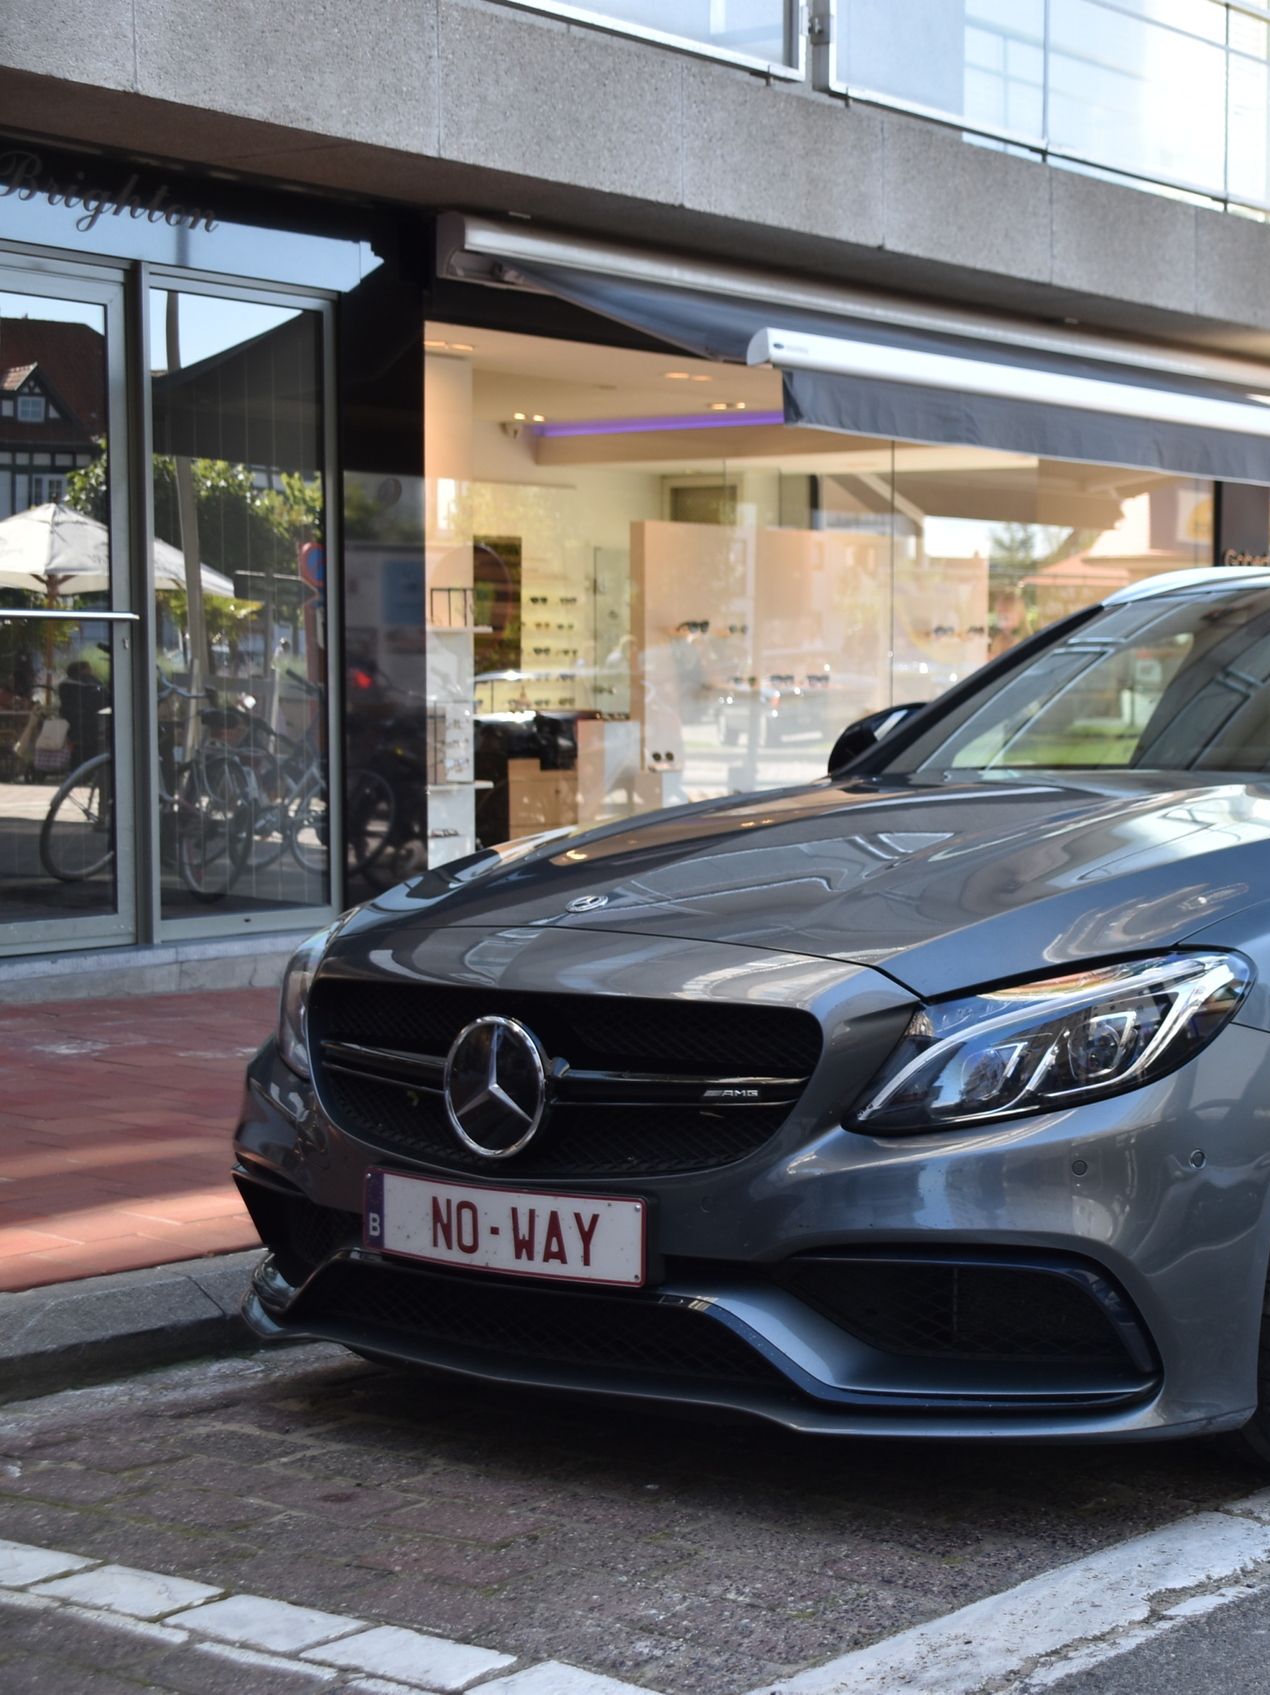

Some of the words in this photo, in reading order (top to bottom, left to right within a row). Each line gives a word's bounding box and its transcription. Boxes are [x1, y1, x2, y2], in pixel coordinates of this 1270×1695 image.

[0, 151, 219, 232] Brighton
[721, 1089, 759, 1097] AMG
[369, 1212, 381, 1237] B
